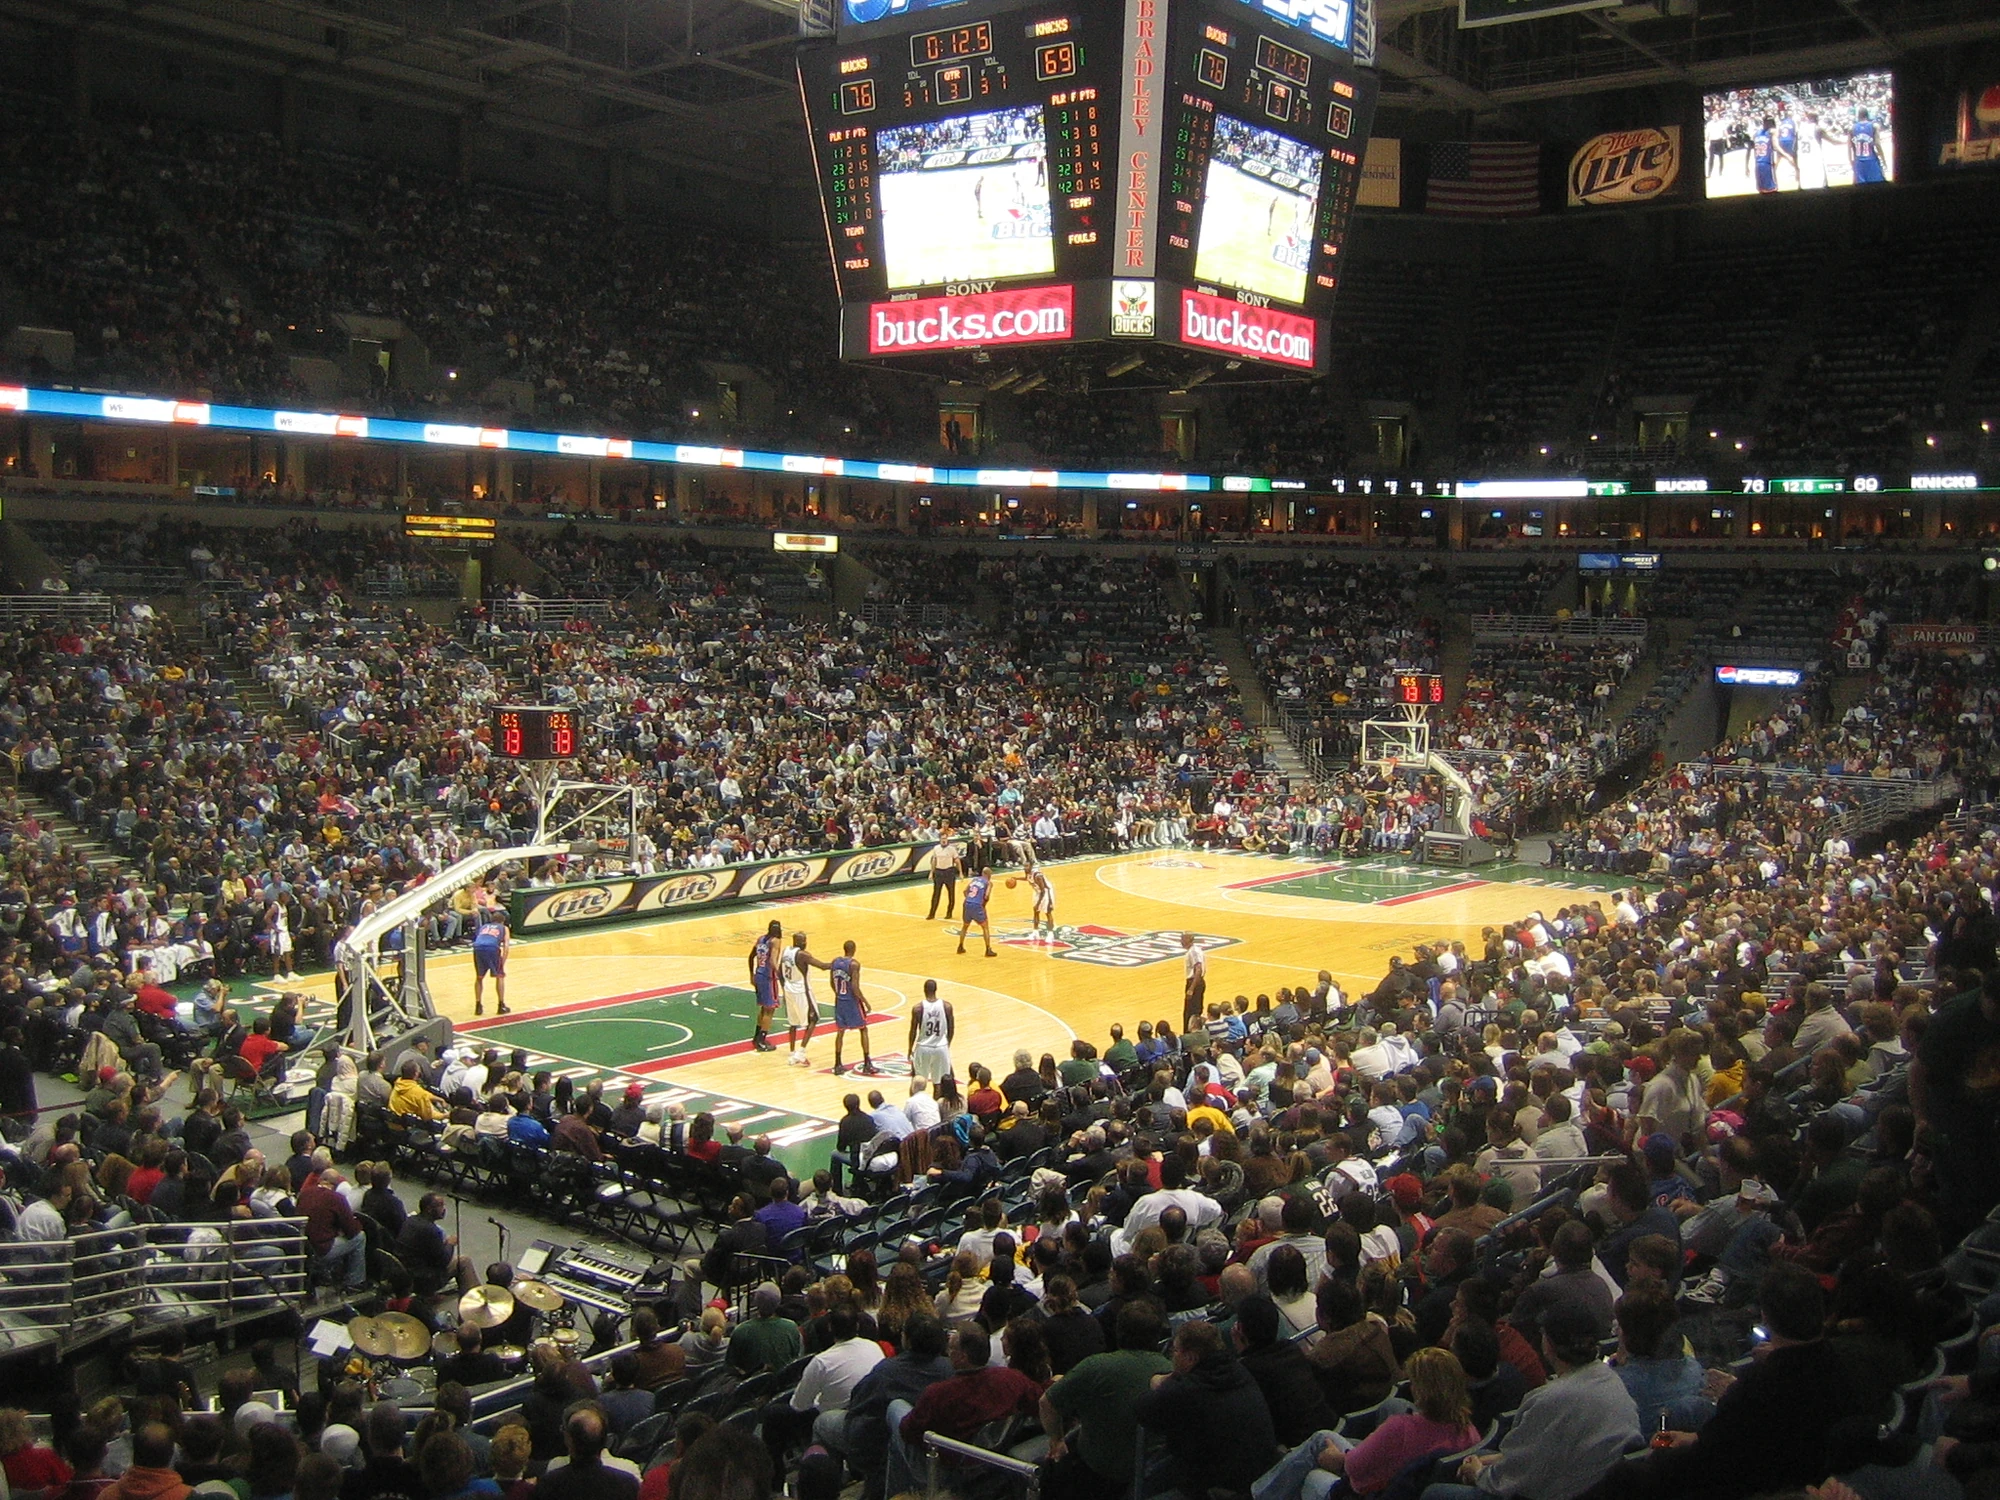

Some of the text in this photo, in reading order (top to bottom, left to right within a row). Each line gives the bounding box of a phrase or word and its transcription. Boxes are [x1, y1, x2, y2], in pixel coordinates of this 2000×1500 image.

[1035, 18, 1069, 36] KNICKS
[927, 26, 989, 60] 0:12.5
[840, 58, 868, 73] BUCKS
[1044, 47, 1072, 75] 69
[1208, 55, 1223, 83] 76
[943, 69, 961, 81] QTR
[850, 83, 872, 107] 76
[904, 91, 912, 107] 3
[950, 83, 958, 99] 3
[1080, 89, 1096, 101] PTS
[1061, 111, 1068, 124] 3
[1601, 132, 1655, 155] Miller
[832, 164, 845, 176] 23
[1580, 141, 1670, 197] Lite
[1069, 197, 1092, 209] TEAM
[1125, 151, 1149, 267] CENTER
[845, 226, 865, 237] TEAM
[1068, 233, 1097, 245] FOULS
[845, 259, 869, 270] FOULS
[946, 281, 997, 297] SONY
[1236, 290, 1271, 309] SONY
[876, 306, 1066, 347] bucks.com
[1115, 316, 1152, 333] BUCKS
[1186, 299, 1310, 361] bucks.com
[1655, 480, 1707, 491] BUCKS
[1741, 480, 1764, 493] 76
[1854, 478, 1878, 492] 69
[1911, 476, 1977, 490] KNICKS
[1913, 630, 1975, 643] FAN STAND
[1406, 687, 1418, 702] 13
[506, 729, 520, 754] 13
[557, 729, 571, 754] 13
[853, 853, 895, 878] Lite
[428, 860, 497, 904] BRADLEY CENTER
[764, 865, 809, 890] Lite
[664, 881, 715, 907] Lite
[554, 893, 606, 918] Lite
[926, 1021, 940, 1036] 34
[1312, 1189, 1339, 1217] 22
